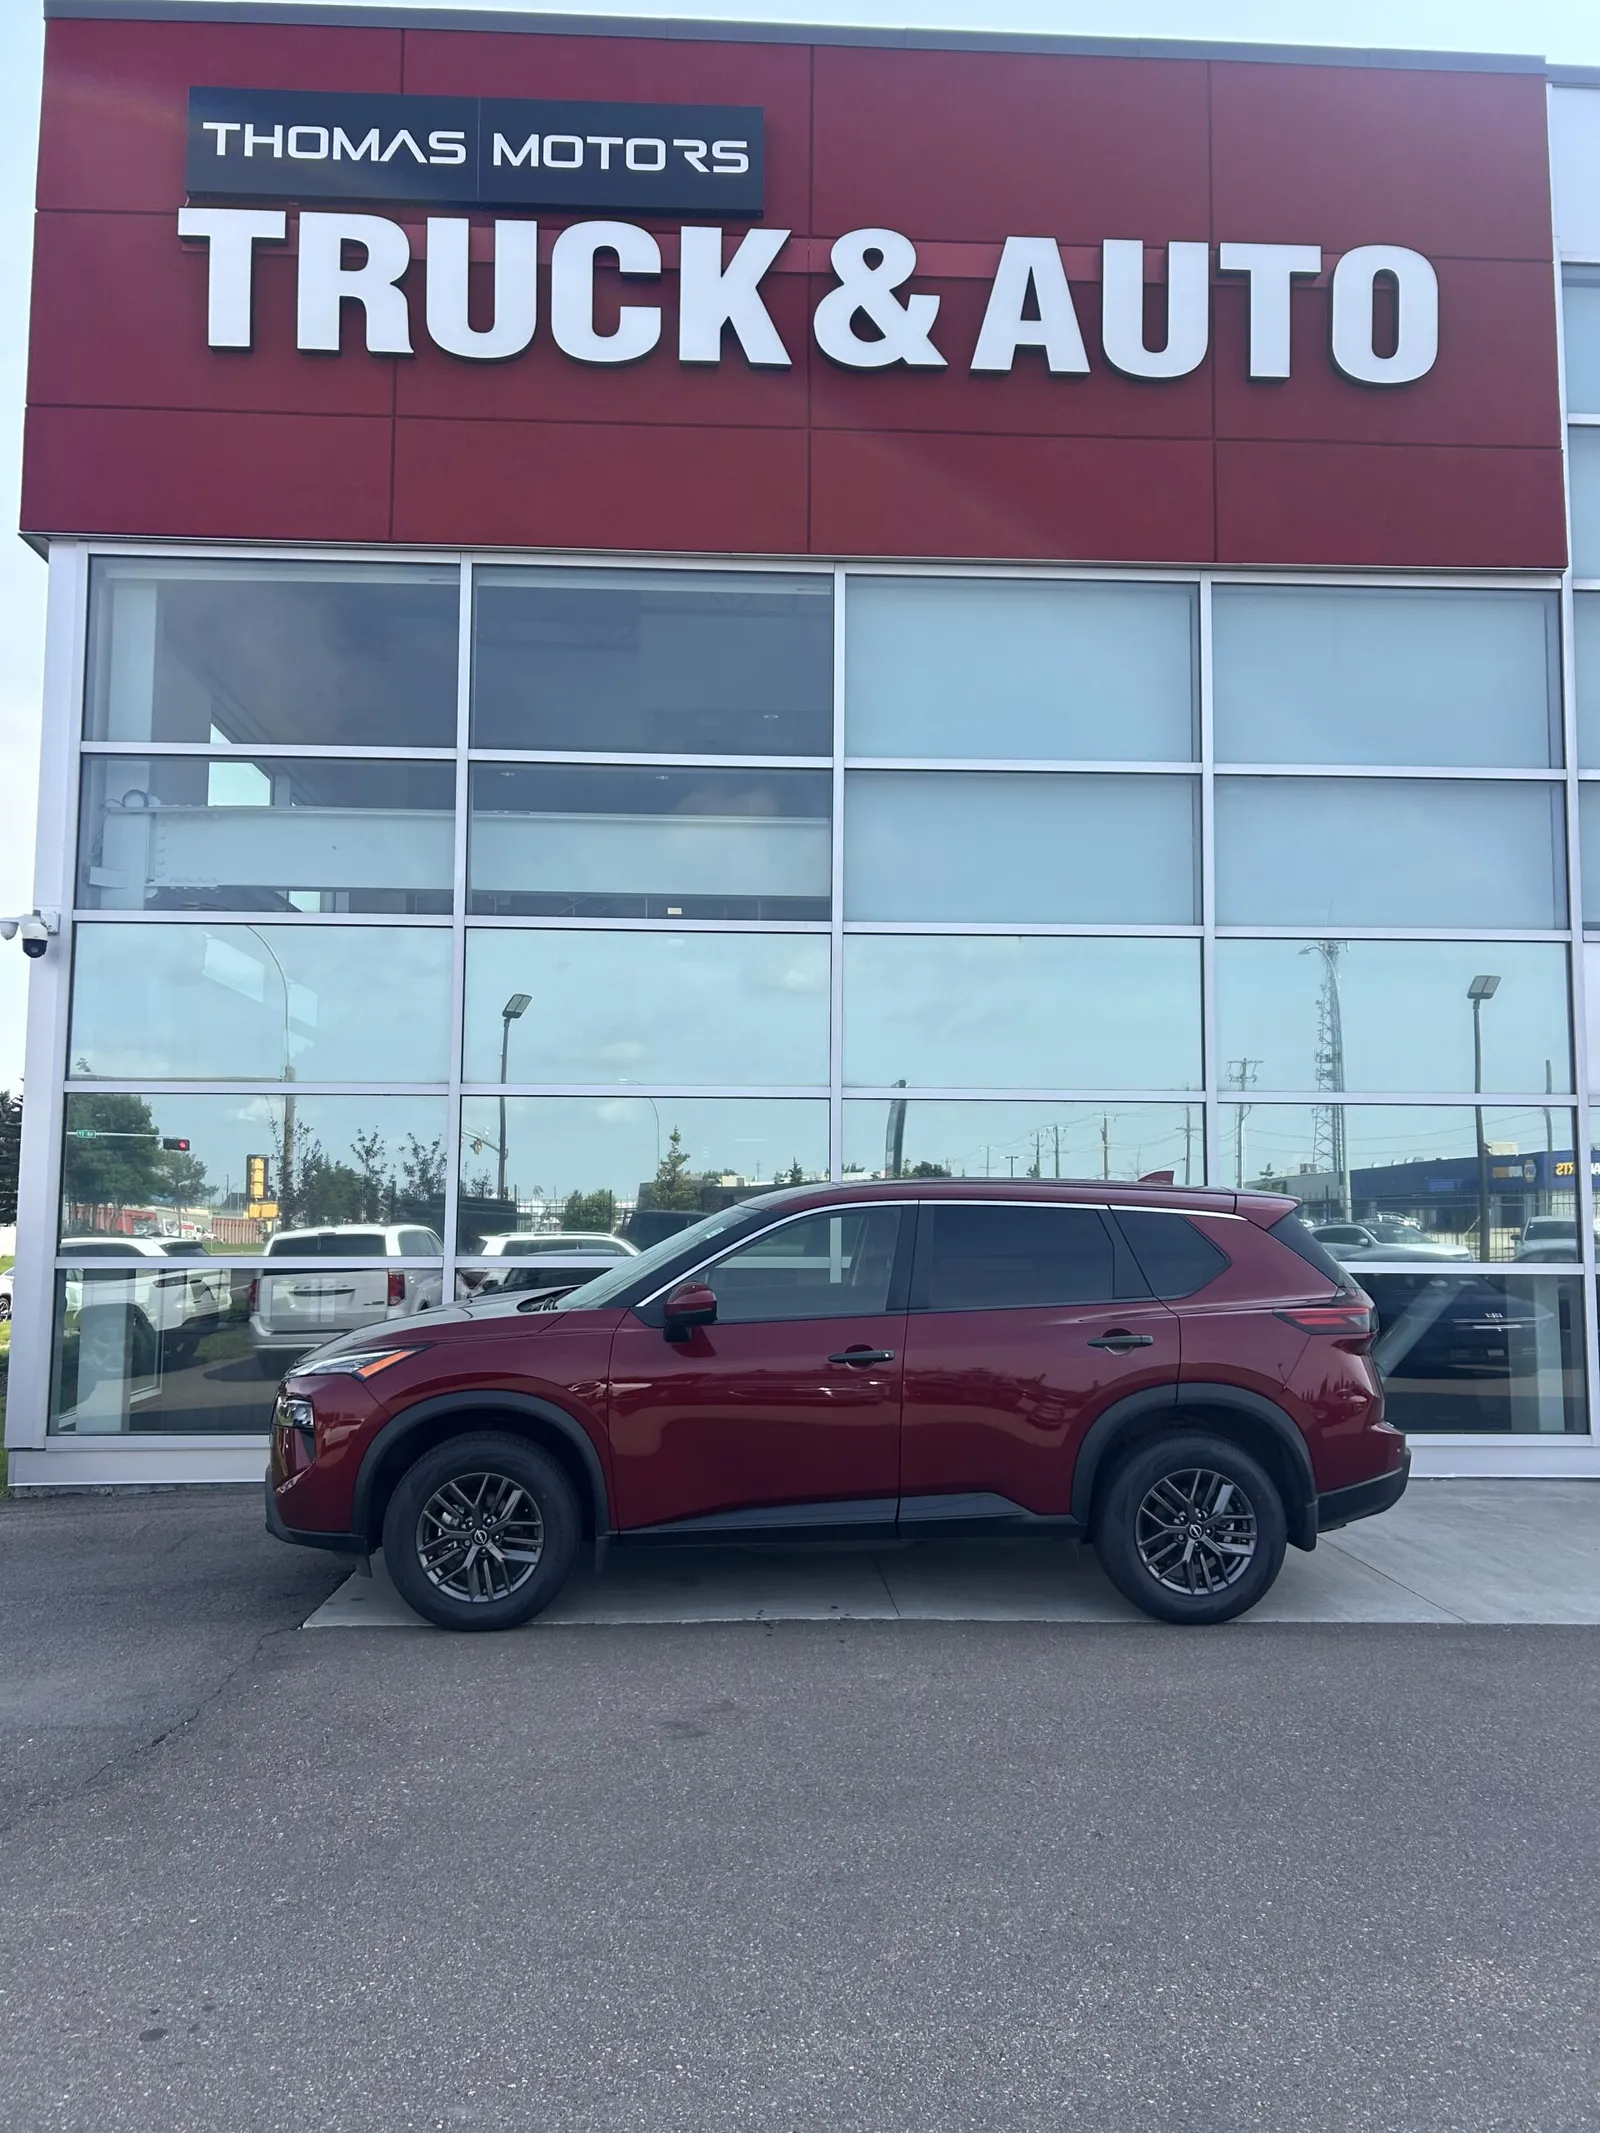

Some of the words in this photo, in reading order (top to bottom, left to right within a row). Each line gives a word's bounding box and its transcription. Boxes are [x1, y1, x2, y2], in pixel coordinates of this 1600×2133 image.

[202, 121, 466, 165] THOMAS
[492, 132, 750, 174] MOTORS
[177, 207, 792, 366] TRUCK
[813, 227, 948, 369] &
[969, 236, 1440, 385] AUTO
